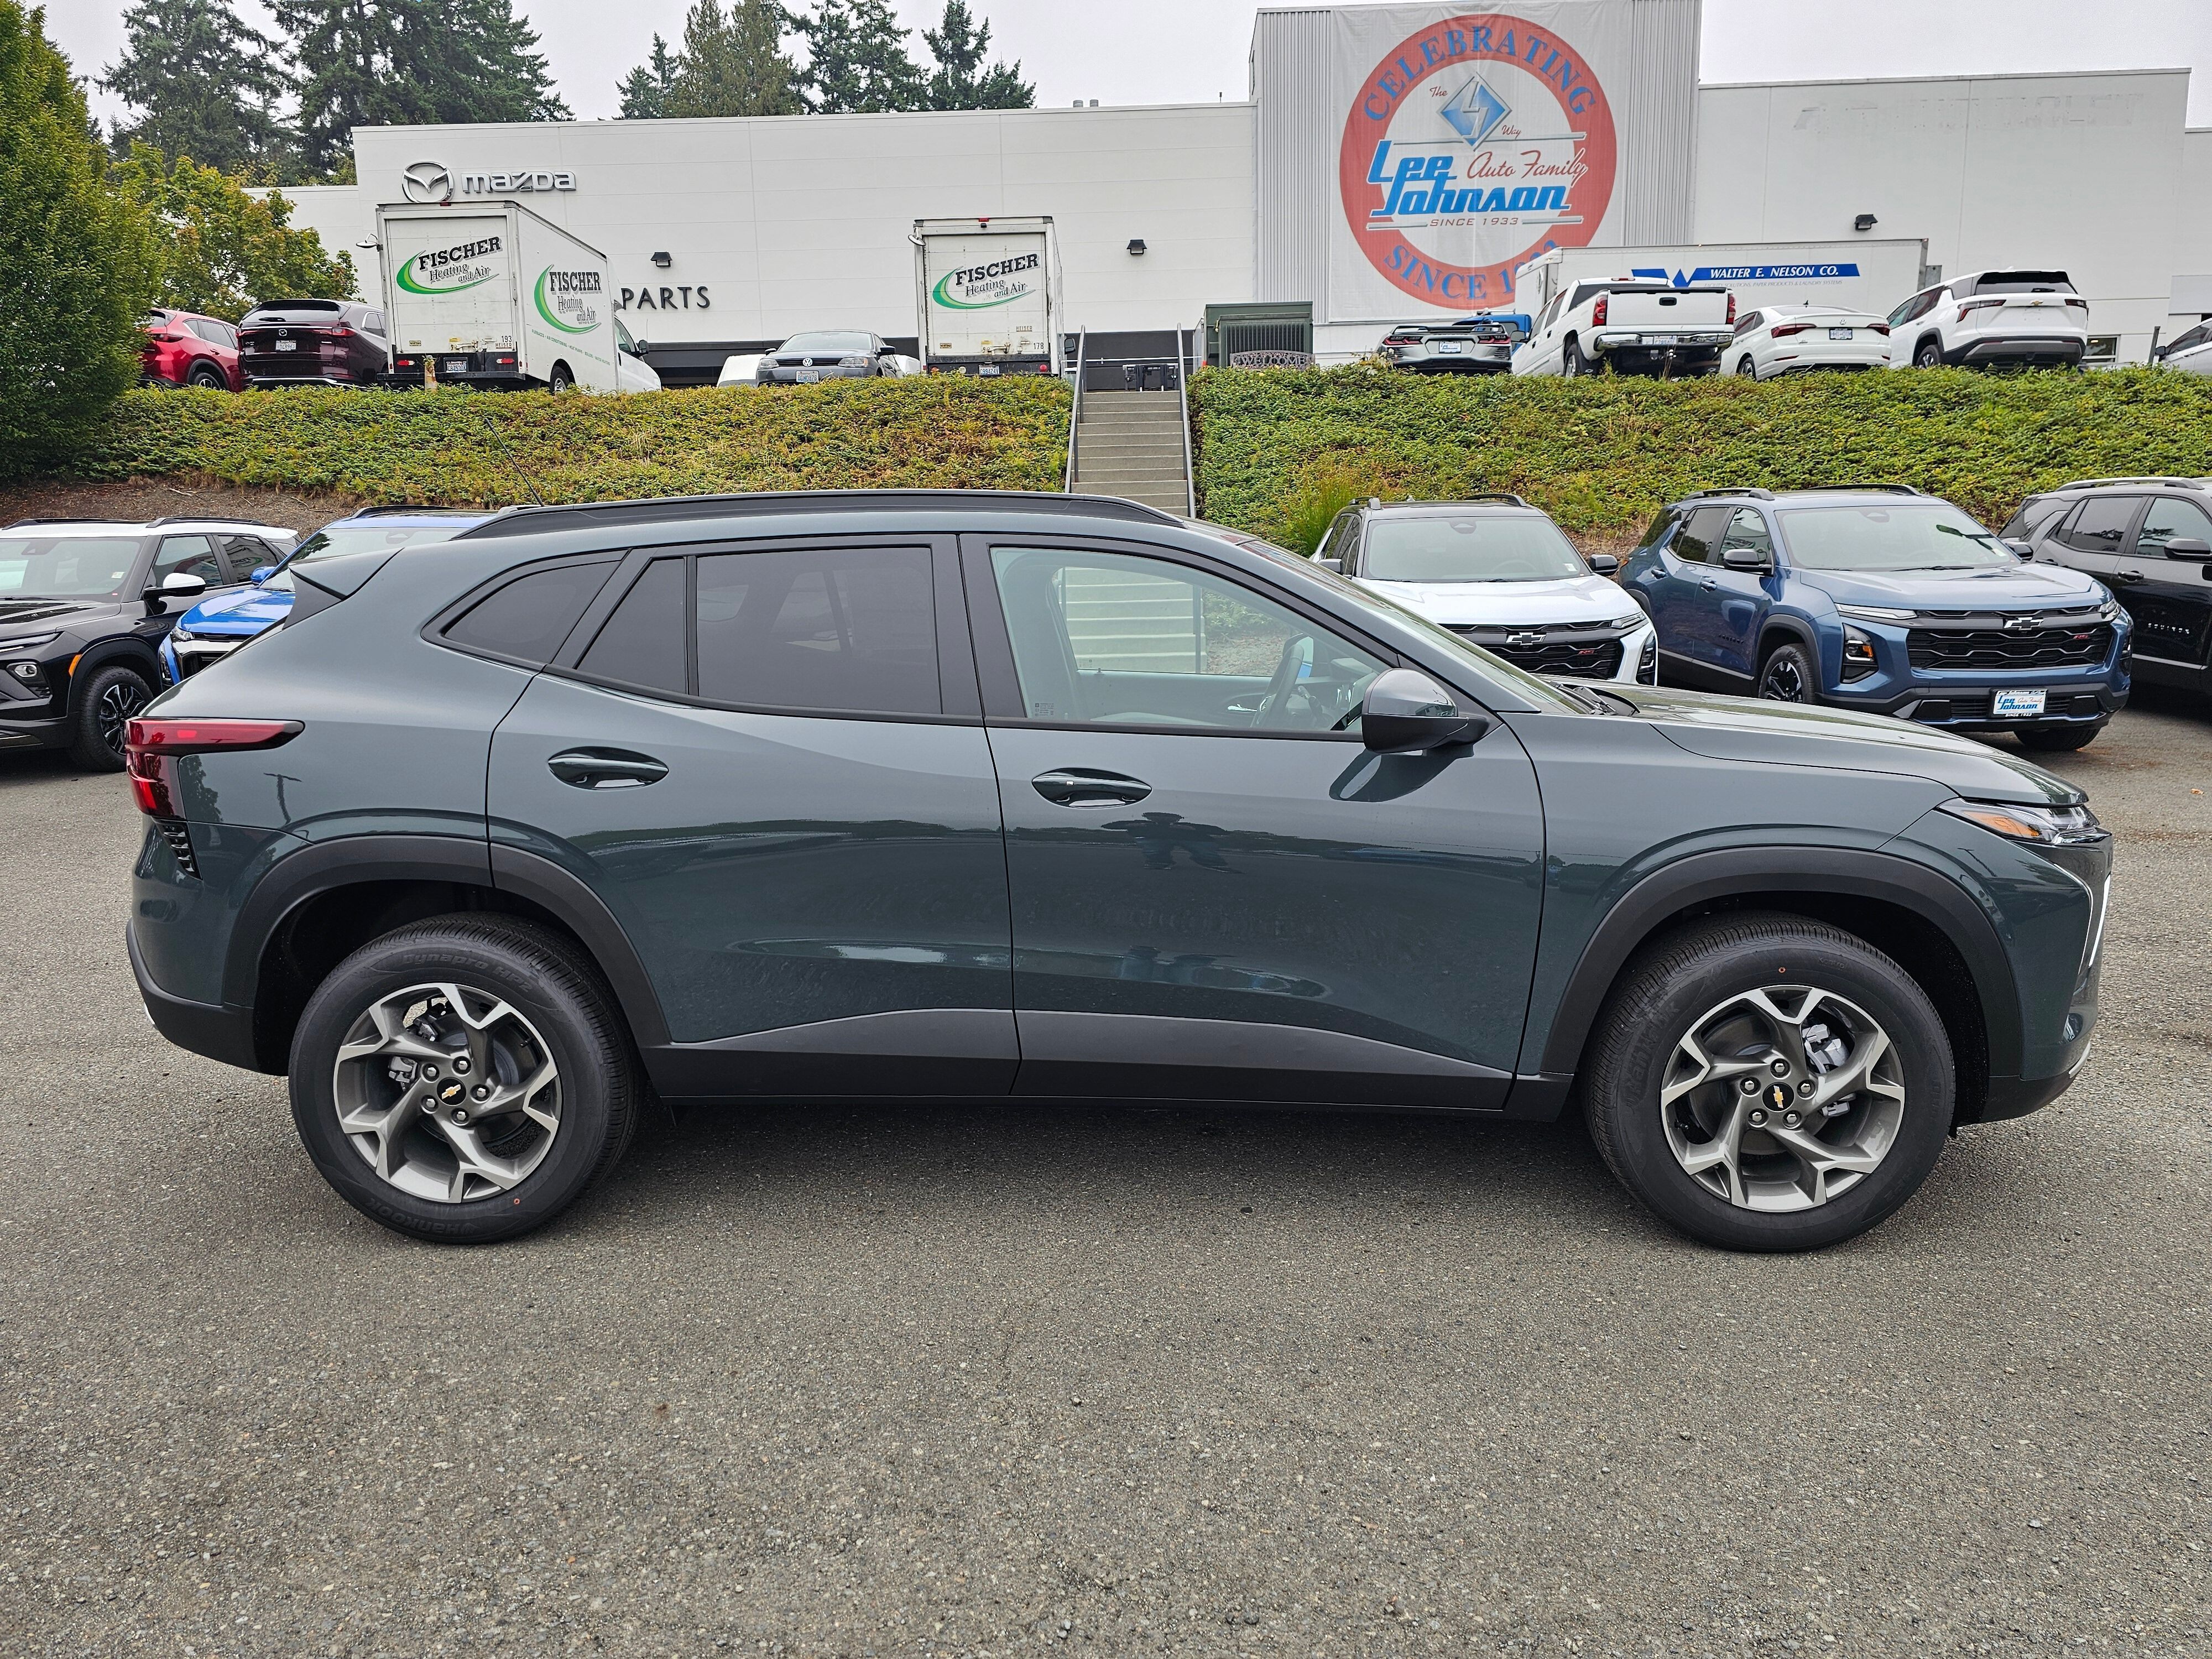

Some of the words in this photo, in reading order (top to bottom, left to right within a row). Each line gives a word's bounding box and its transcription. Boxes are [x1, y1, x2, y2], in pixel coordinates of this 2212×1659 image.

[1364, 26, 1597, 121] CELEBRATING
[1430, 86, 1448, 97] The
[1501, 125, 1521, 140] Way
[1368, 140, 1457, 183] Lee
[1467, 152, 1516, 179] Auto
[1519, 148, 1588, 186] Family
[1371, 168, 1570, 216] Johnson
[1430, 218, 1474, 227] SINCE
[1483, 217, 1519, 226] 1933
[419, 237, 500, 270] FISCHER
[429, 264, 468, 281] Heating
[458, 272, 472, 282] and
[474, 265, 489, 278] Air
[956, 253, 1038, 285] FISCHER
[1385, 245, 1486, 300] SINCE
[1710, 268, 1750, 278] WALTER
[1756, 268, 1764, 277] E.
[1770, 267, 1814, 277] NELSON
[1820, 265, 1839, 275] CO.
[549, 272, 601, 291] FISCHER
[966, 280, 1005, 296] Heating
[994, 287, 1008, 297] and
[1010, 281, 1026, 294] Air
[557, 295, 583, 312] Heating
[622, 286, 711, 310] PARTS
[577, 310, 586, 321] and
[586, 306, 596, 321] Air
[1240, 355, 1306, 365] WELCOME
[1997, 695, 2016, 704] Lee
[1997, 701, 2038, 710] Johnson
[403, 954, 489, 970] Dynapro
[493, 966, 533, 992] HP2
